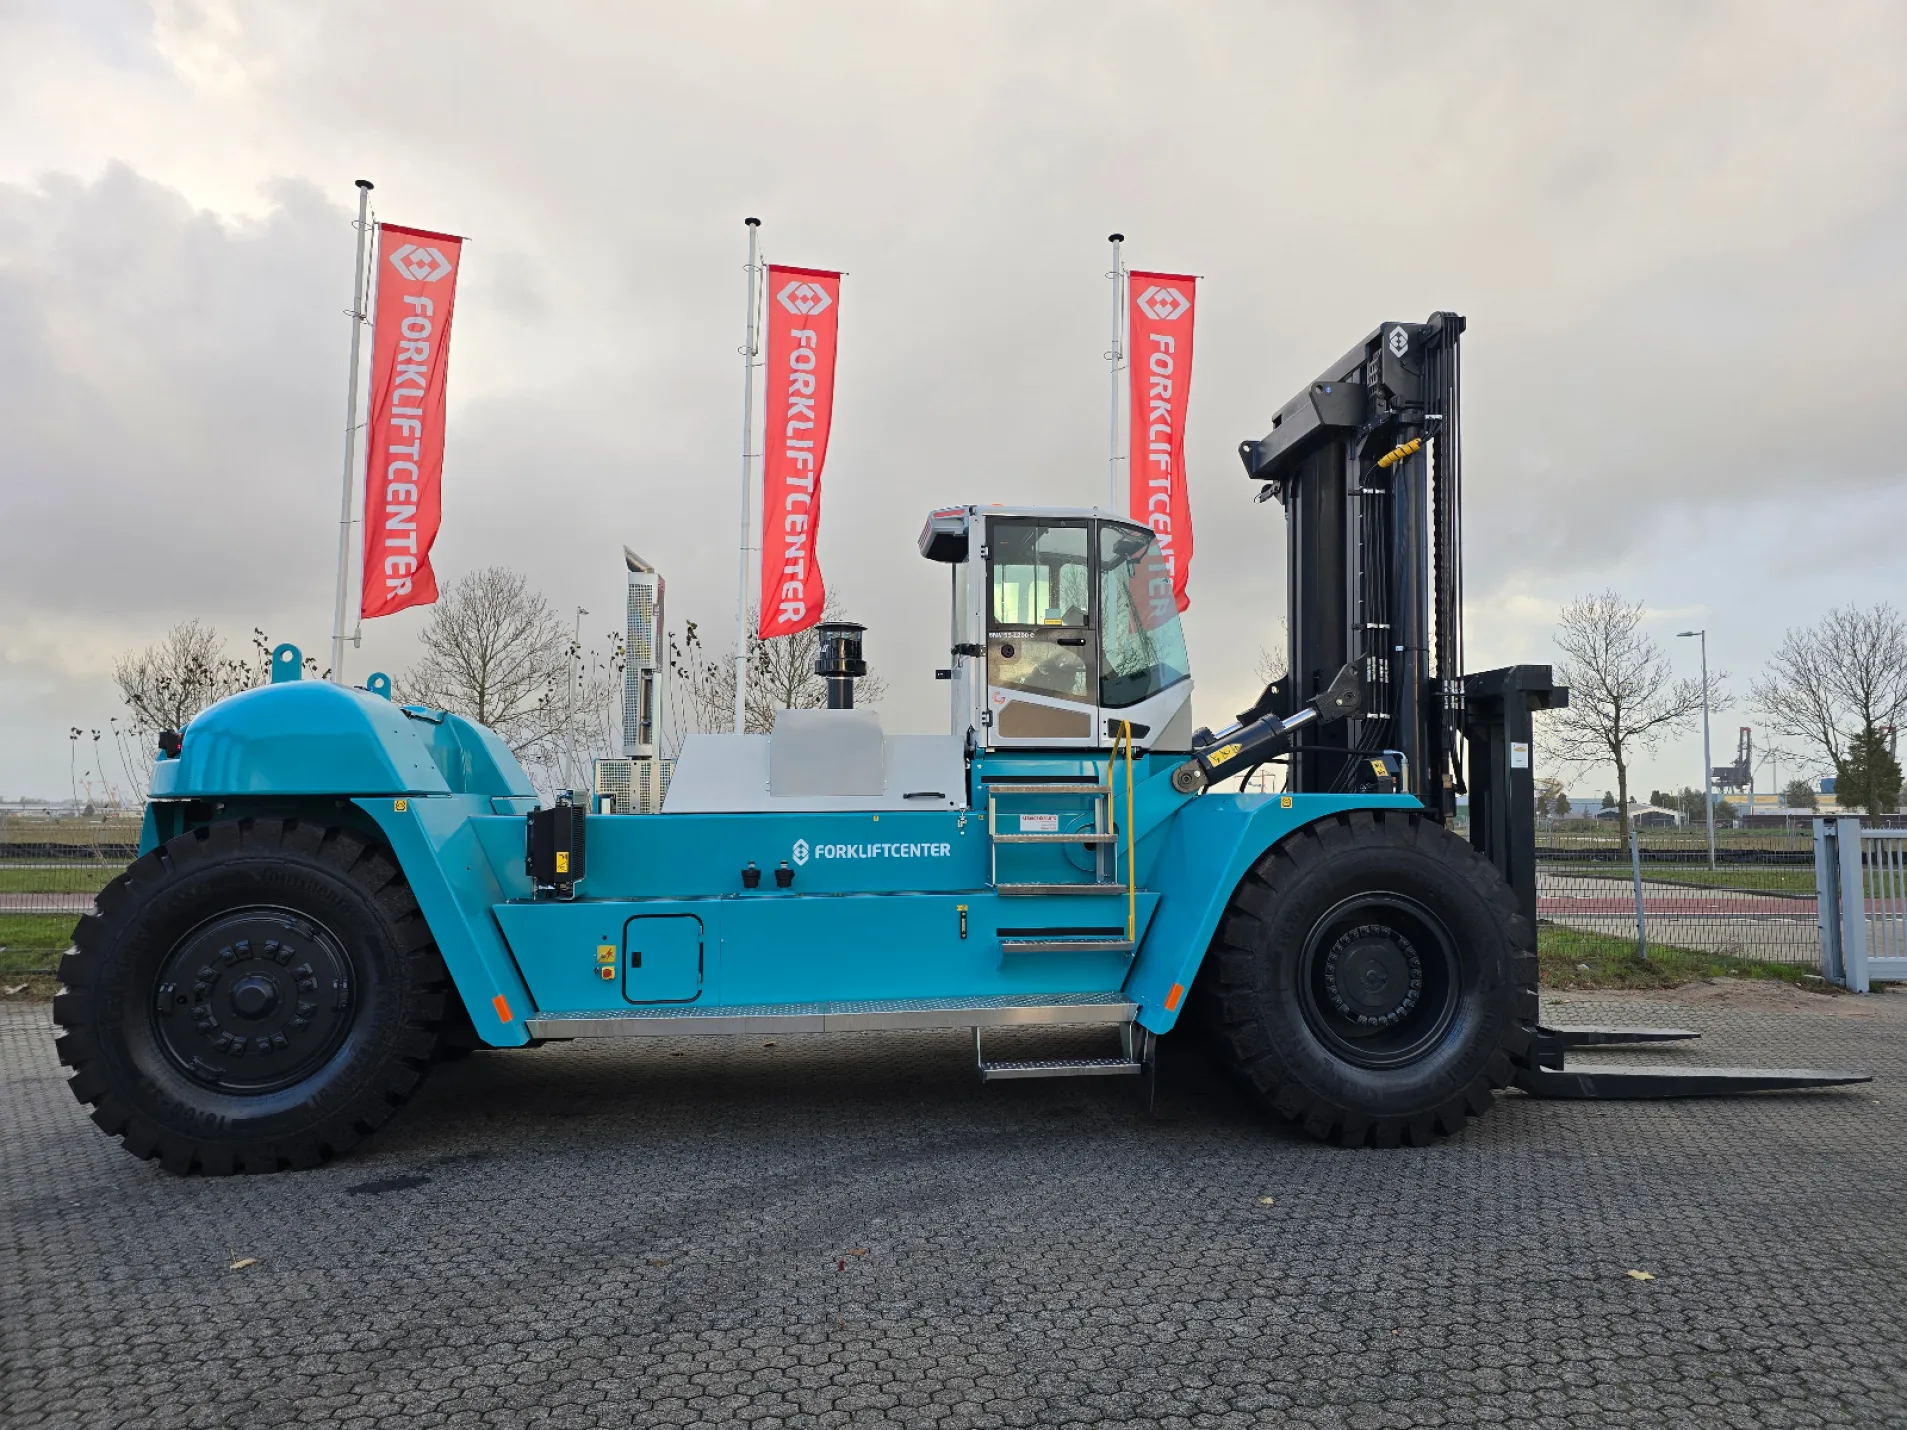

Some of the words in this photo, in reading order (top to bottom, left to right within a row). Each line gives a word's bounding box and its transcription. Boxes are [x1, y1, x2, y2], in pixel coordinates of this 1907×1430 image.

[384, 295, 434, 600] FORKLIFTCENTER
[778, 328, 817, 624] FORKLIFTCENTER
[1148, 333, 1176, 618] FORKLIFTCENTER
[814, 843, 951, 859] FORKLIFTCENTER
